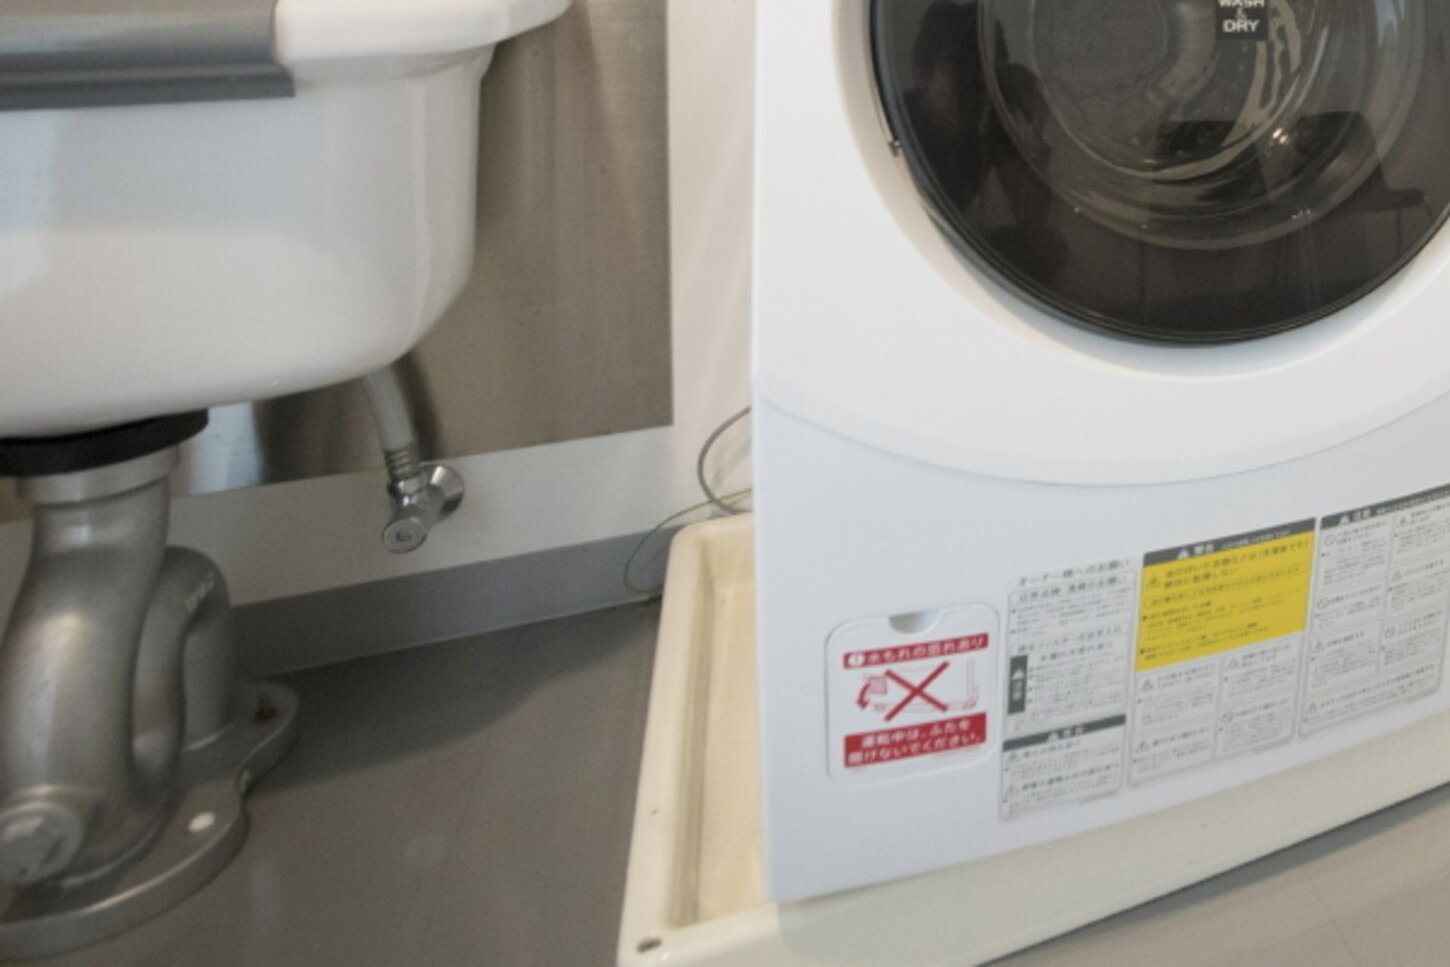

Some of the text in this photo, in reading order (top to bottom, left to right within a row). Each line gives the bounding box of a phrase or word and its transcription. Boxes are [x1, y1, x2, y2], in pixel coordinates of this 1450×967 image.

[1223, 19, 1260, 33] DRY
[867, 635, 984, 664] 水もれの恐れあり
